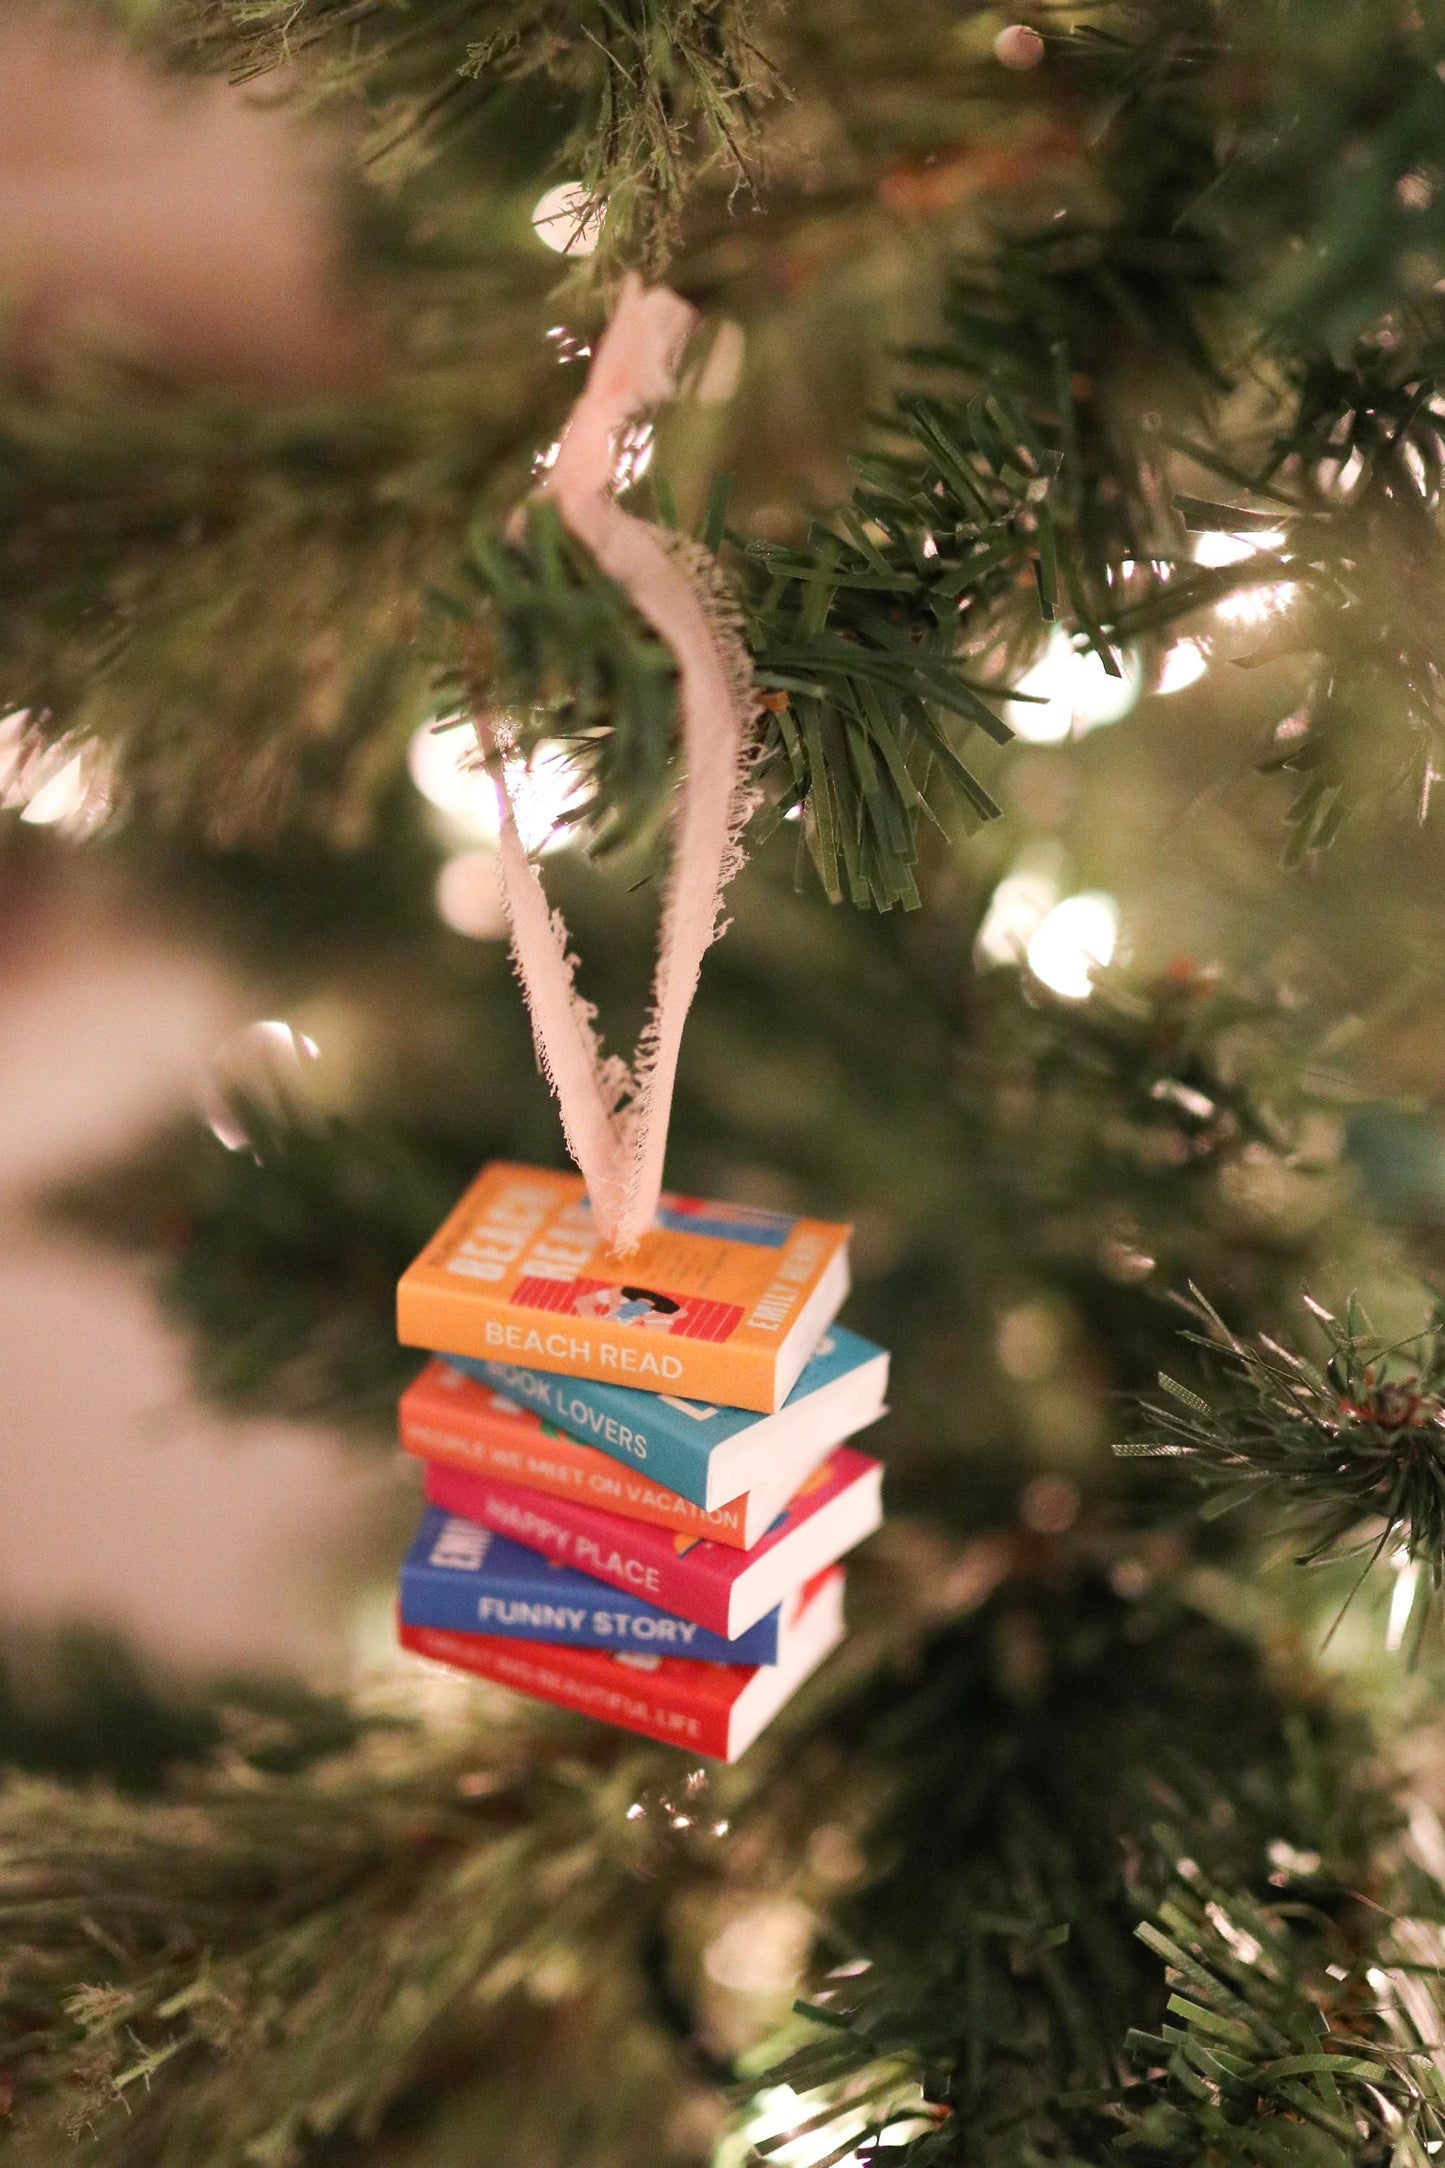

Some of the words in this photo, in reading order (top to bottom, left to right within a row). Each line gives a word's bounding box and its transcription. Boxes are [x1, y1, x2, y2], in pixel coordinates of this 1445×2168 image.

[485, 1321, 591, 1364] BEACH
[599, 1343, 683, 1379] READ
[556, 1389, 648, 1459] LOVERS
[528, 1456, 582, 1484] MEET
[588, 1473, 622, 1497] ON
[485, 1495, 571, 1551] HAPPY
[575, 1535, 661, 1593] PLACE
[478, 1597, 586, 1632] FUNNY
[592, 1610, 698, 1643] STORY
[654, 1707, 701, 1738] LIFE
